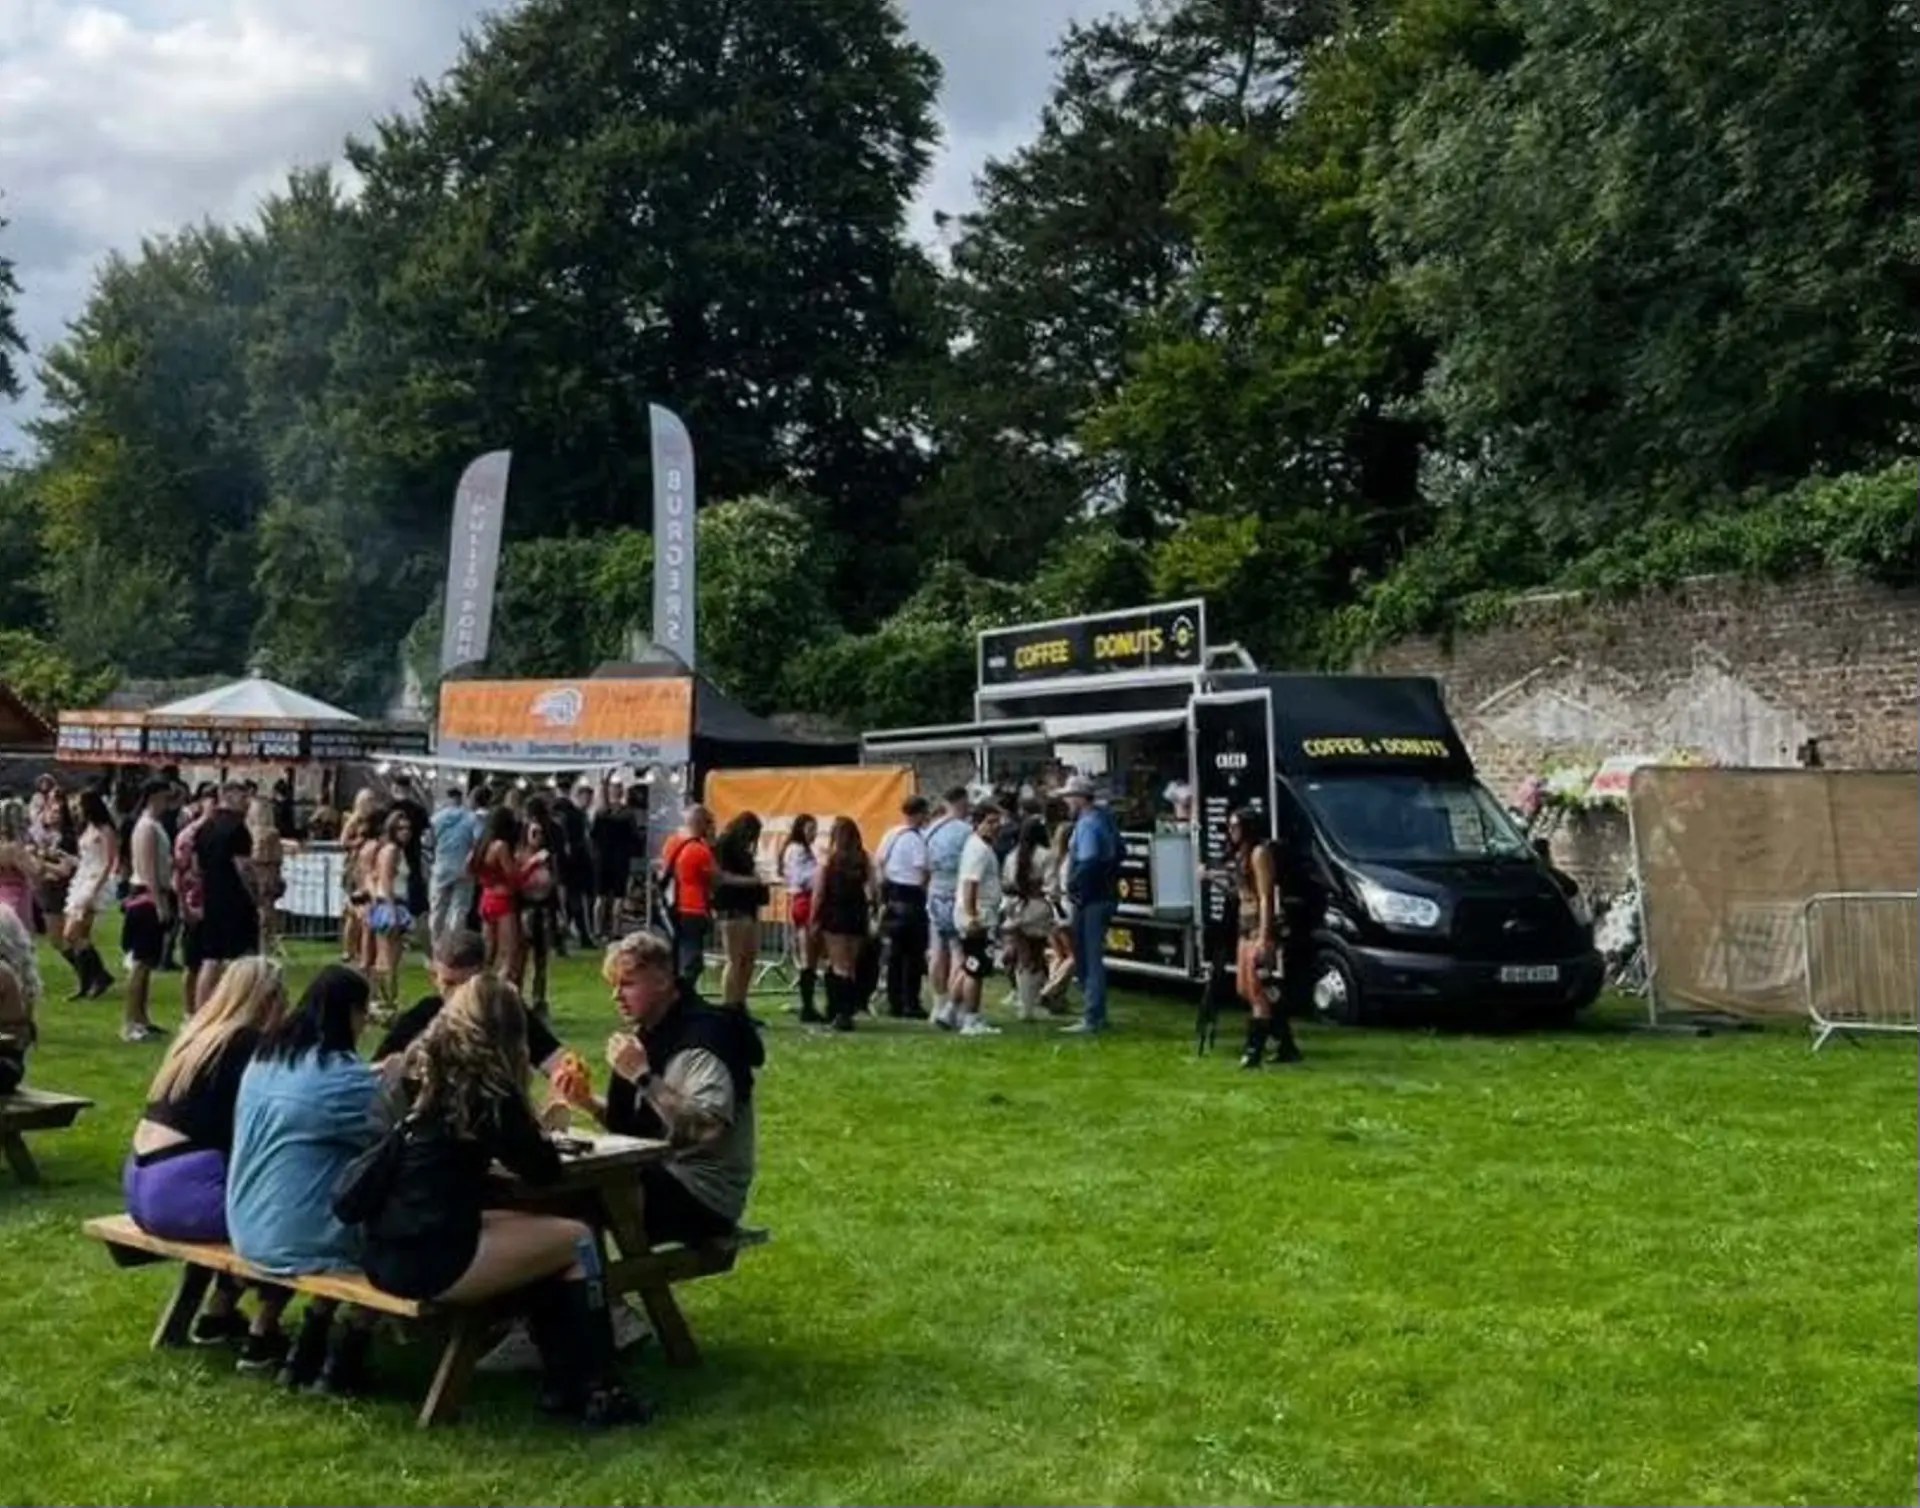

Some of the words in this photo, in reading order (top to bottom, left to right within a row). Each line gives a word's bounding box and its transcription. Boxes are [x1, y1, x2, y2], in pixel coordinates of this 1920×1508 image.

[1013, 638, 1071, 670] COFFEE
[1093, 626, 1163, 658] DONUTS
[1302, 737, 1370, 757] COFFEE
[1383, 738, 1450, 758] DONUTS
